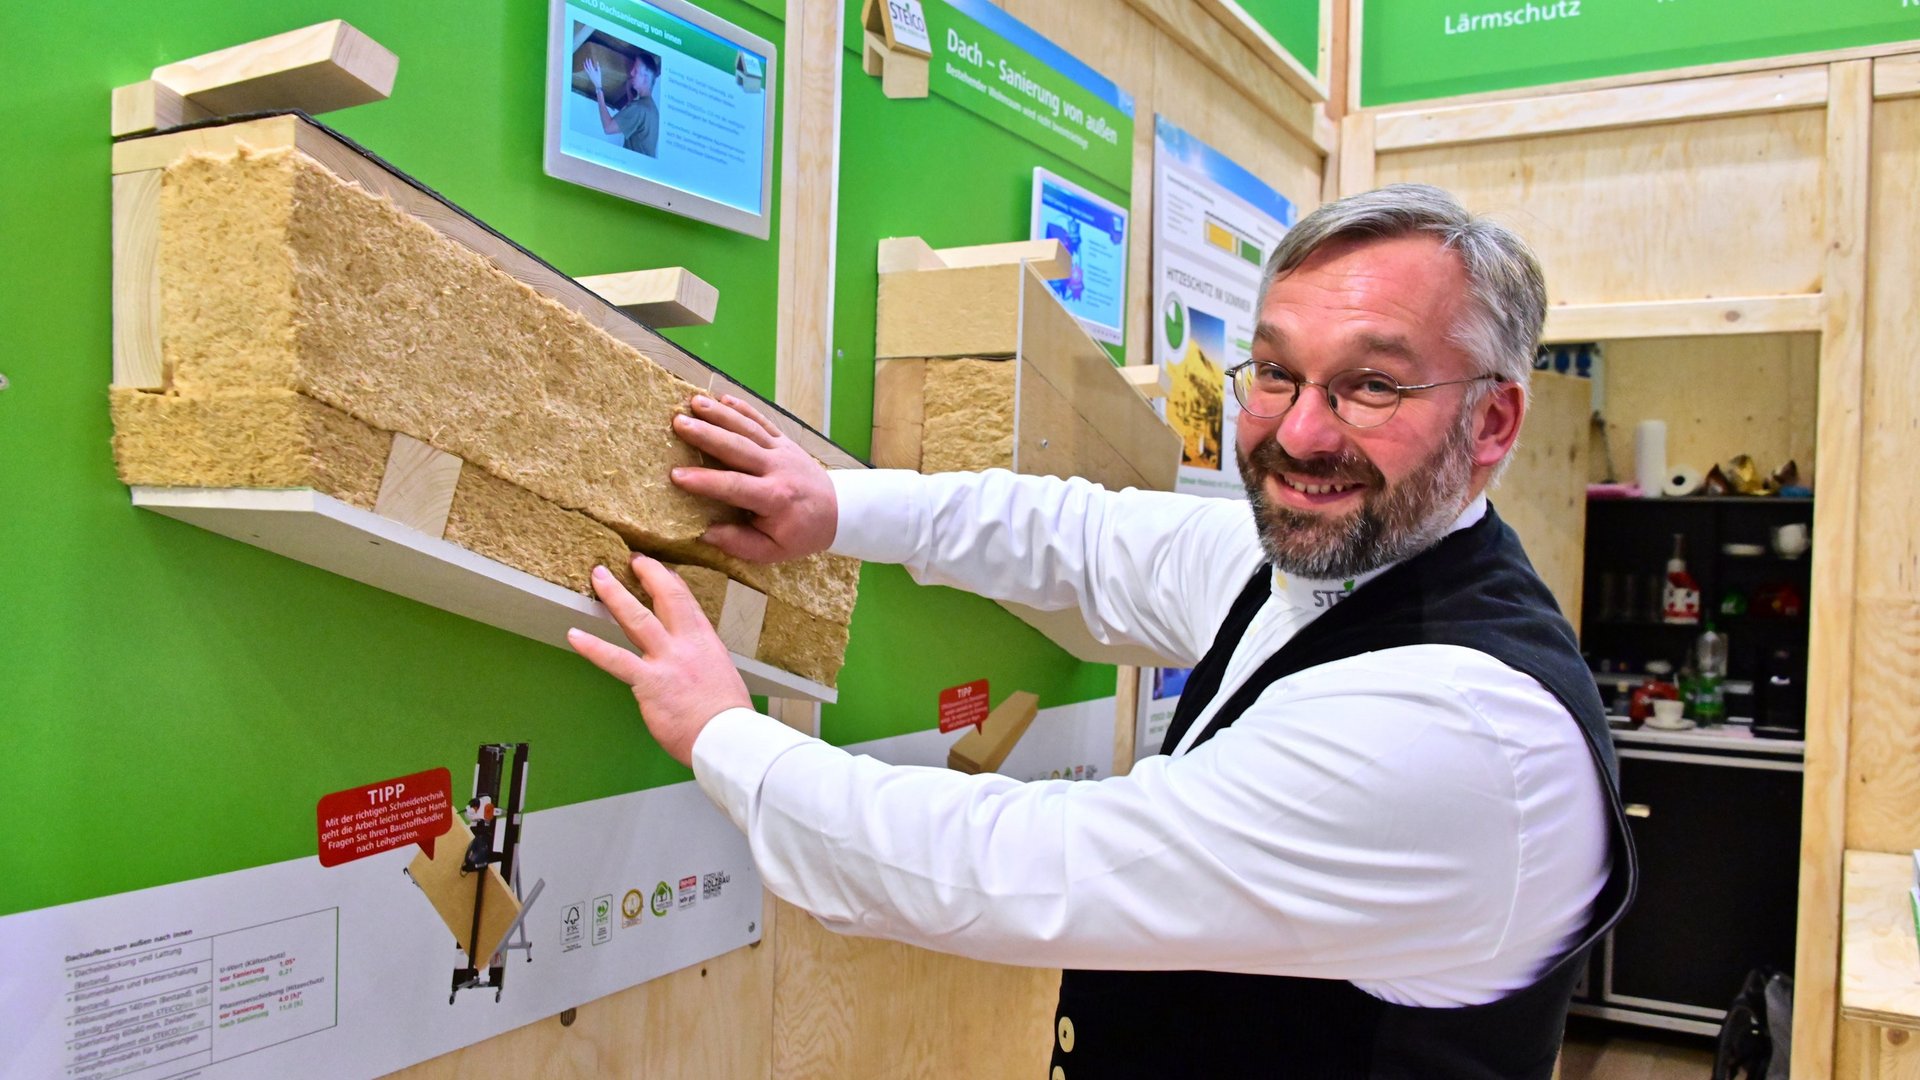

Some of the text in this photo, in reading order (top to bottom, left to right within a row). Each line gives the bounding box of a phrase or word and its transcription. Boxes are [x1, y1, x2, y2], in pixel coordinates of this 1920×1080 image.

[600, 2, 649, 33] Dachsanierung
[651, 25, 663, 36] von
[664, 30, 682, 45] innen
[890, 2, 925, 32] STEICO
[1444, 0, 1581, 34] Lärmschutz
[947, 27, 983, 68] Dach
[999, 59, 1060, 118] Sanierung
[1063, 100, 1083, 125] von
[1086, 114, 1117, 145] außen
[1166, 266, 1214, 297] HITZESCHUTZ
[957, 686, 973, 699] TIPP
[367, 783, 405, 806] TIPP
[325, 790, 444, 828] Mit der richtigen Schneidetechnik
[321, 829, 339, 842] geht
[341, 825, 353, 836] die
[355, 819, 378, 831] Arbeit
[379, 814, 399, 826] leicht
[400, 811, 414, 820] von
[415, 806, 427, 815] der
[328, 812, 444, 850] Fragen Sie Ihren Baustoffhändler
[356, 830, 419, 853] nach Leihgeräten.
[65, 947, 111, 963] Dachaufbau
[129, 938, 152, 948] außen
[154, 933, 171, 942] nach
[173, 929, 193, 938] innen
[138, 952, 153, 963] und
[127, 979, 141, 989] und
[219, 983, 235, 992] nach
[237, 974, 270, 987] Sanierung
[232, 966, 265, 980] Sanierung
[219, 1012, 231, 1020] vor
[232, 1002, 265, 1016] Sanierung
[219, 1019, 236, 1028] nach
[237, 1010, 269, 1024] Sanierung
